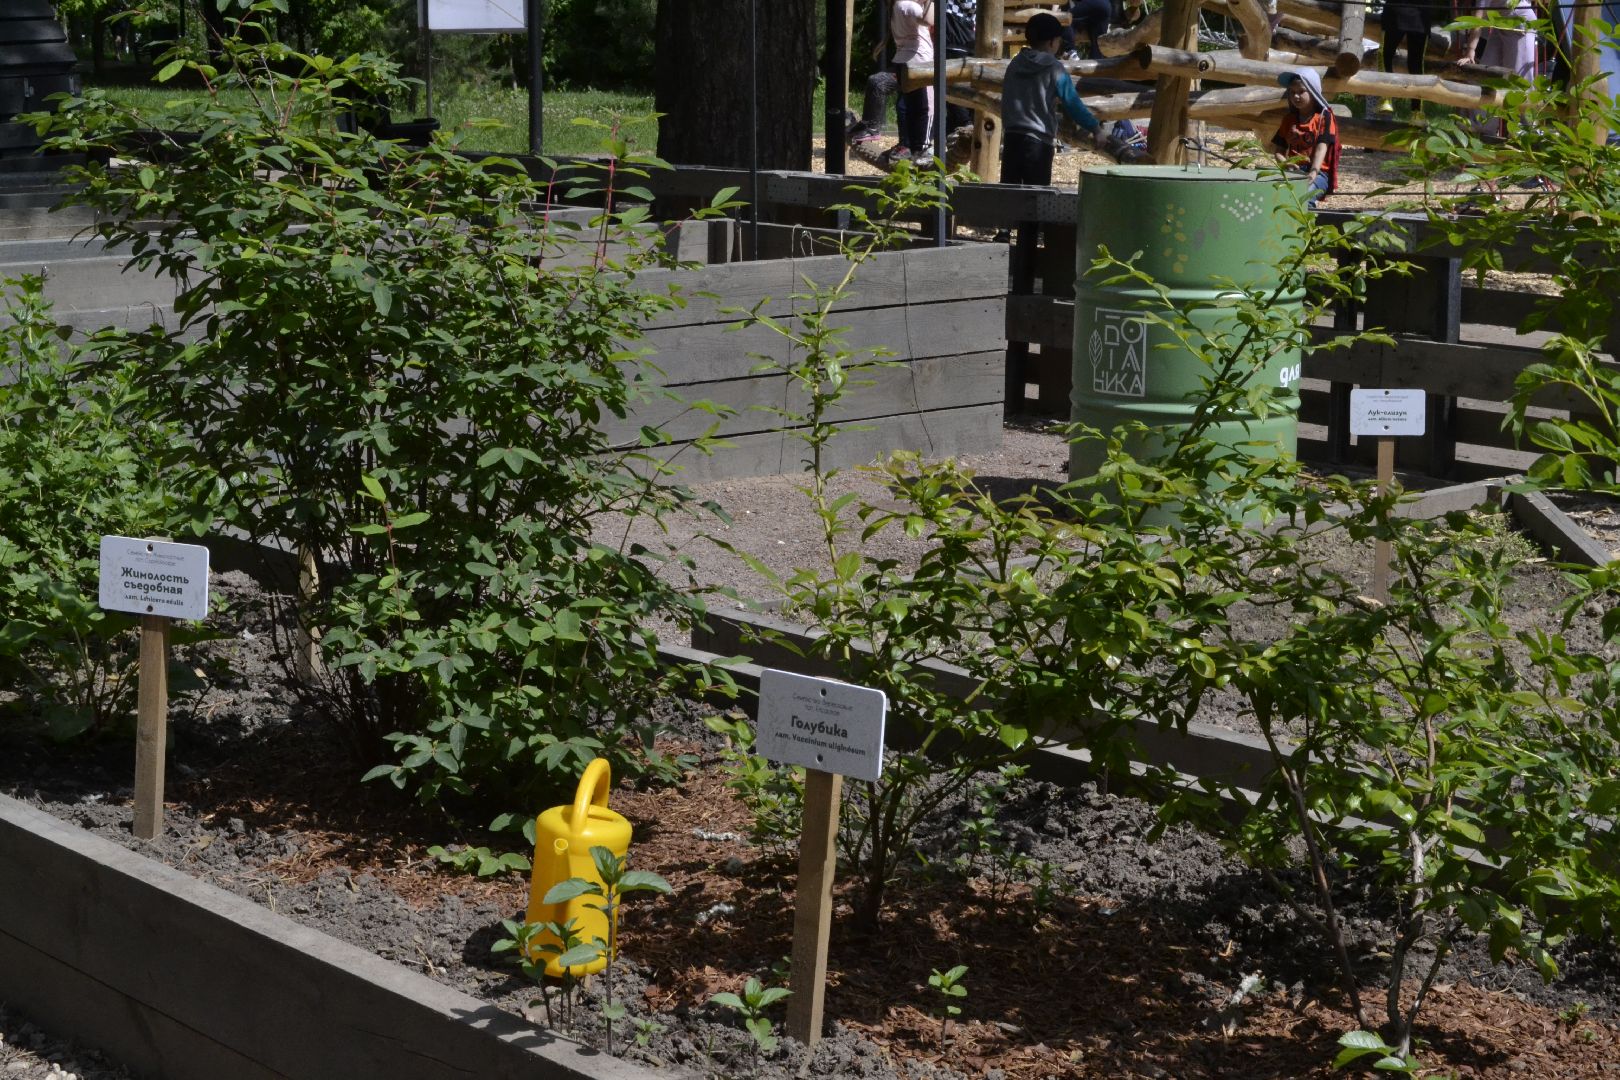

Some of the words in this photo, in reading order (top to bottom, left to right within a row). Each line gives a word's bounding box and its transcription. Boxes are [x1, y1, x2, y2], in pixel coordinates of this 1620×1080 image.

[121, 566, 190, 584] Жимолость
[123, 580, 183, 595] съедобная
[790, 714, 848, 738] Голубика
